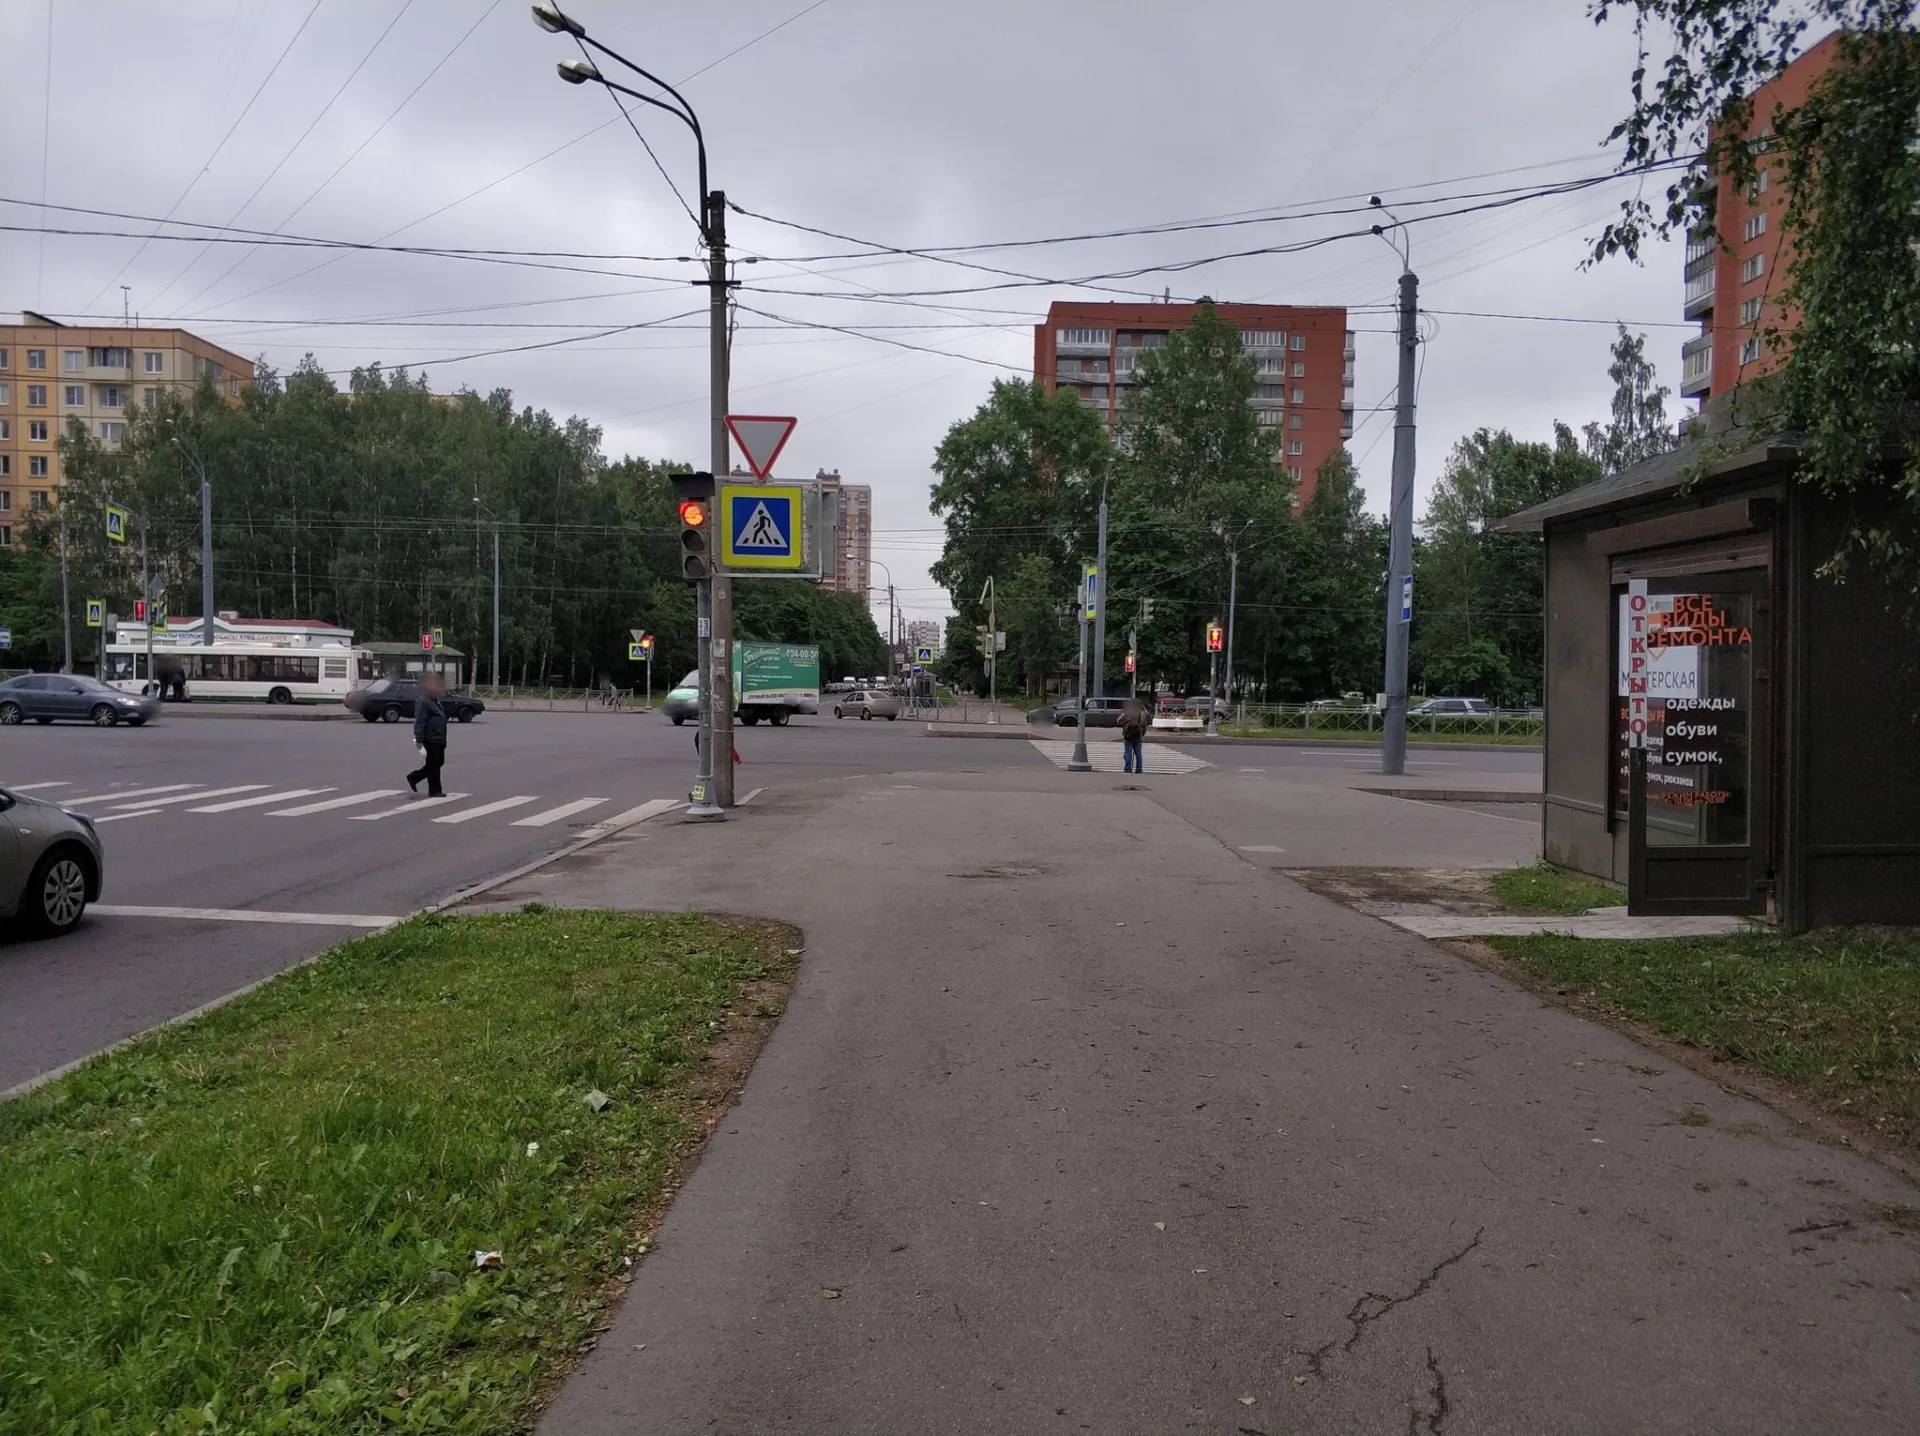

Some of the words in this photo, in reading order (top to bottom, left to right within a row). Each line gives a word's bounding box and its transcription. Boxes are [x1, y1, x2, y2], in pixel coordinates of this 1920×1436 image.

[1674, 594, 1712, 612] ВСЕ
[1660, 610, 1725, 628] ВИДЫ
[1647, 627, 1752, 648] РЕМОНТА
[1630, 595, 1647, 736] ОТКРЫТО
[1621, 671, 1695, 690] МТЕРСКАЯ
[1666, 698, 1735, 711] одежды
[1665, 720, 1717, 740] обуви
[1665, 751, 1723, 765] сумок,
